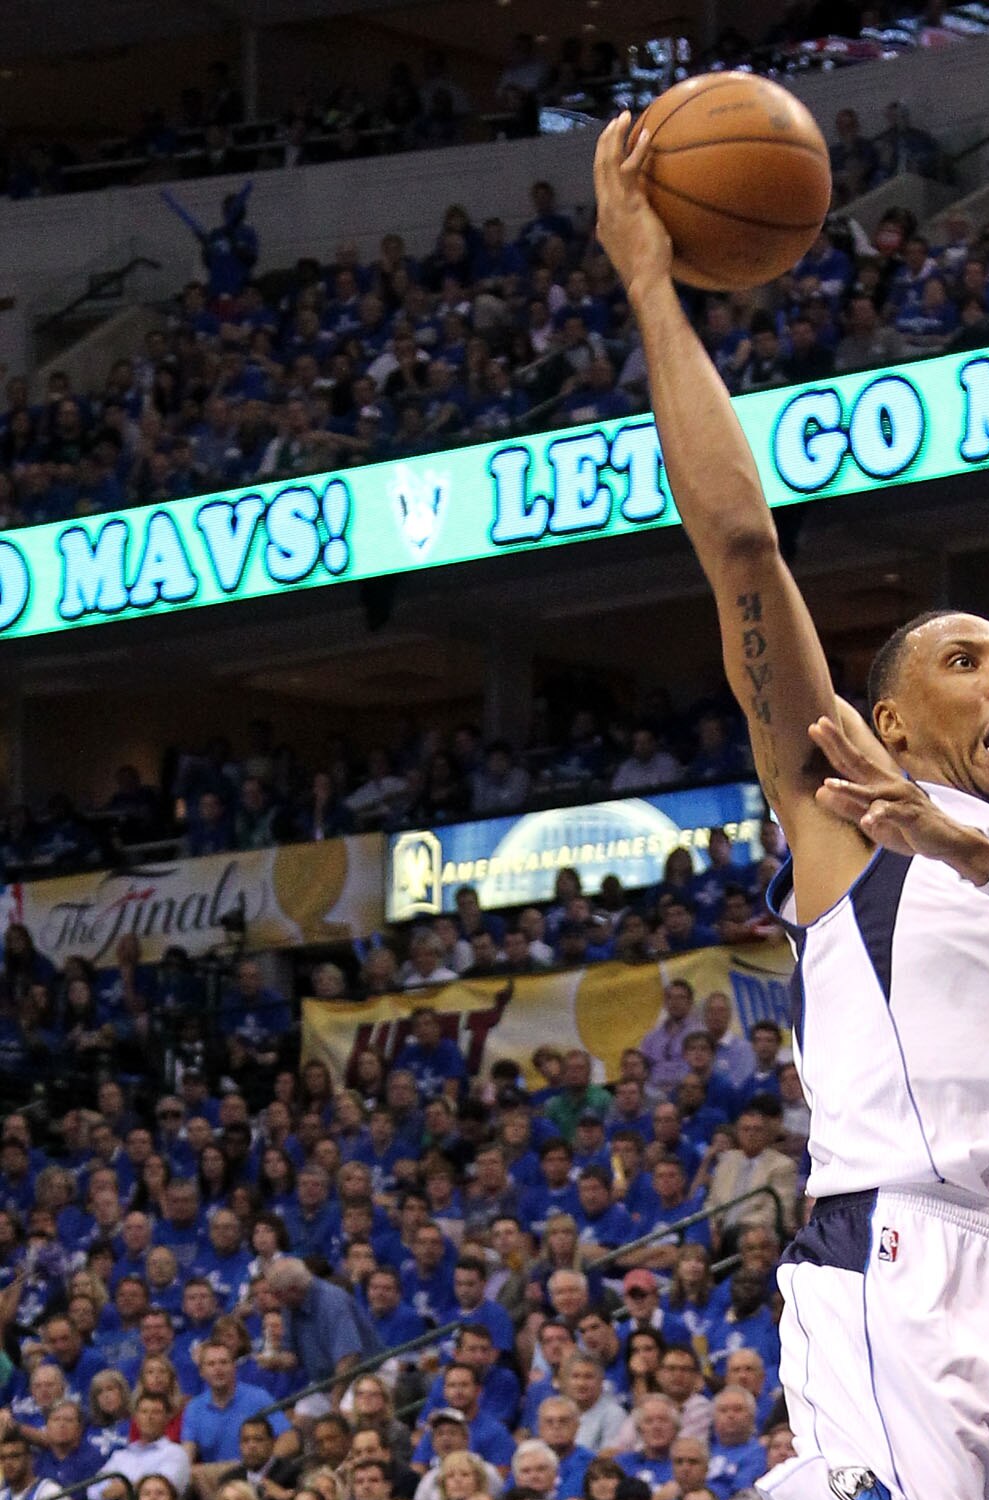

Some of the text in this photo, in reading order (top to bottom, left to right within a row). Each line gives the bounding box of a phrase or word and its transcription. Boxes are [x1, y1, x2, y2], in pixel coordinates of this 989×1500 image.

[487, 421, 667, 546] LET
[773, 375, 926, 492] GO
[57, 478, 351, 621] MAVS!
